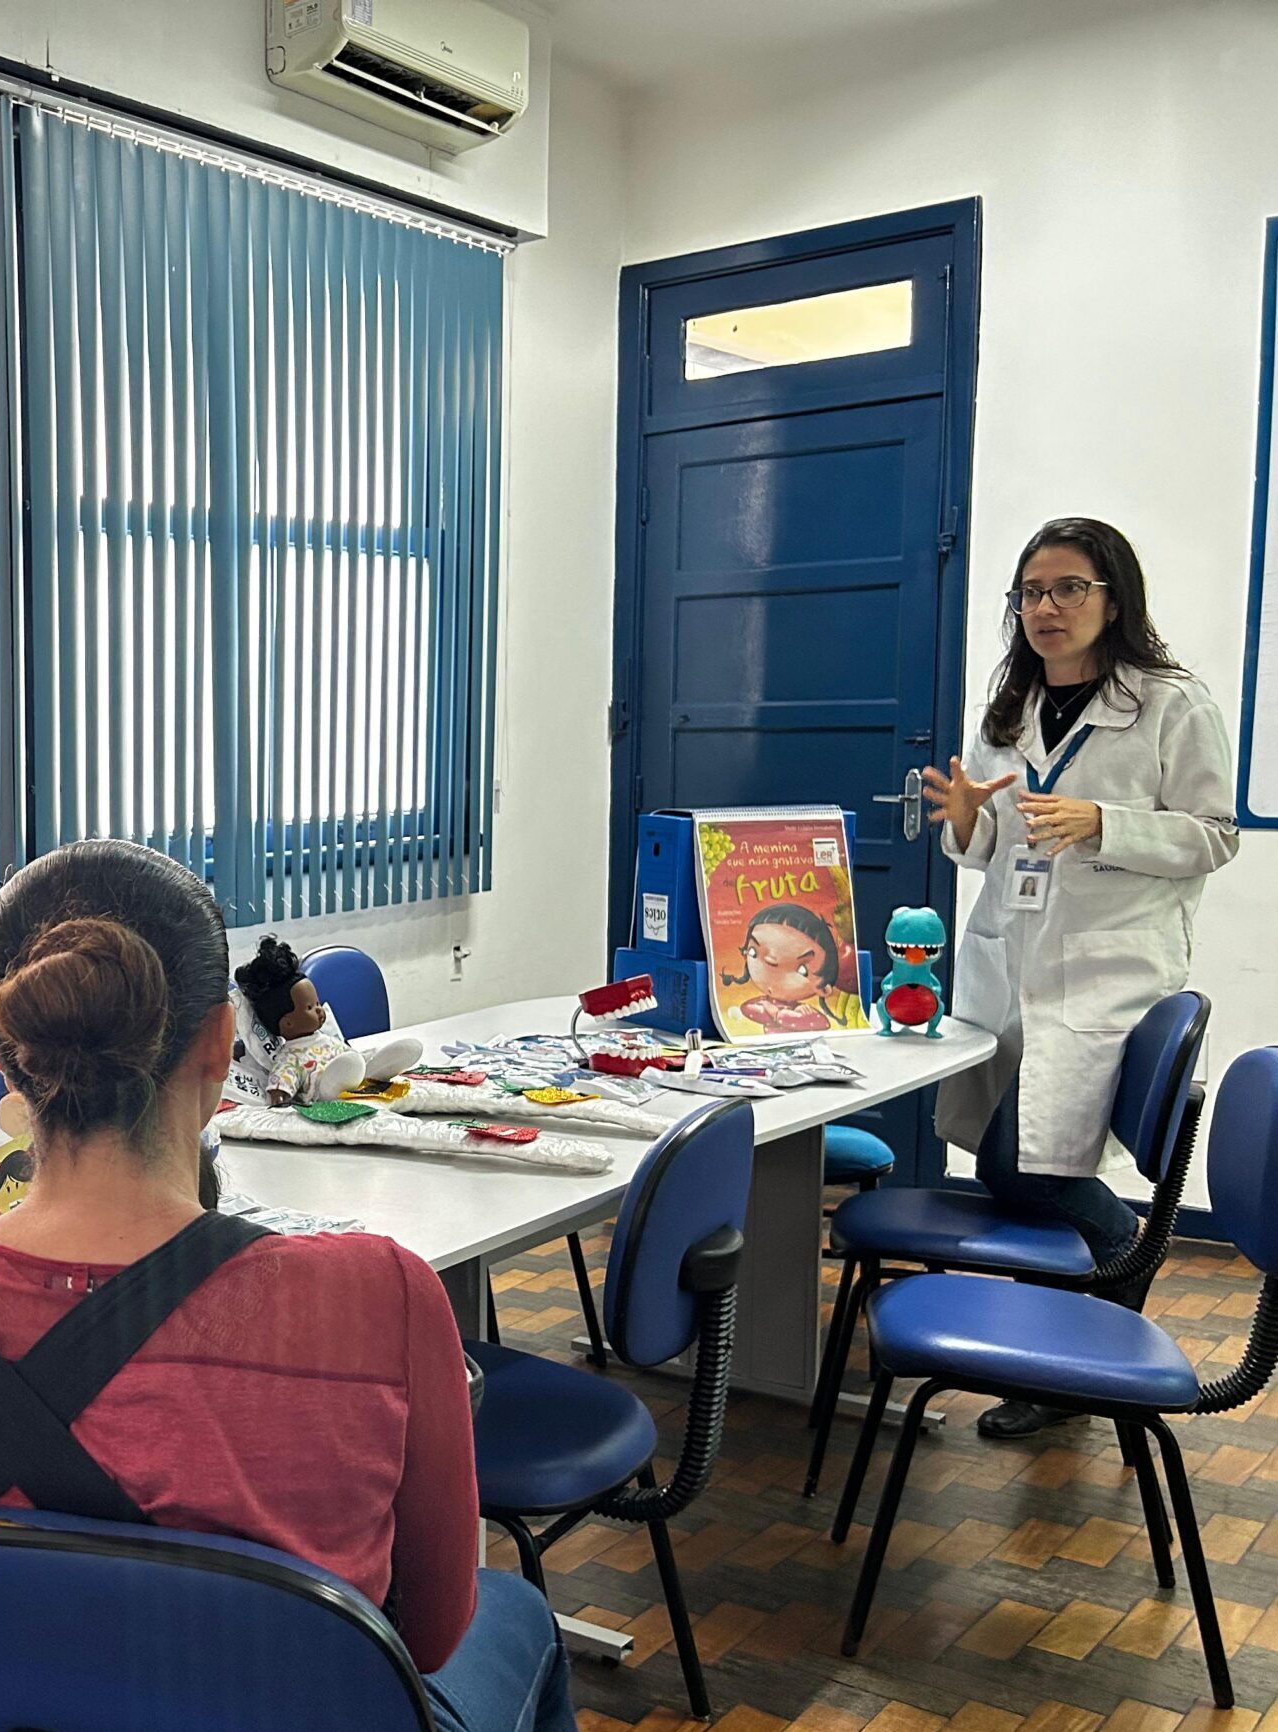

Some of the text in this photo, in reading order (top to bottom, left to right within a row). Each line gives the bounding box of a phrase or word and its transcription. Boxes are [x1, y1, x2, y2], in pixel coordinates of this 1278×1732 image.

[740, 841, 798, 854] A menina
[727, 859, 745, 869] que
[749, 856, 769, 866] não
[772, 856, 813, 869] gostava
